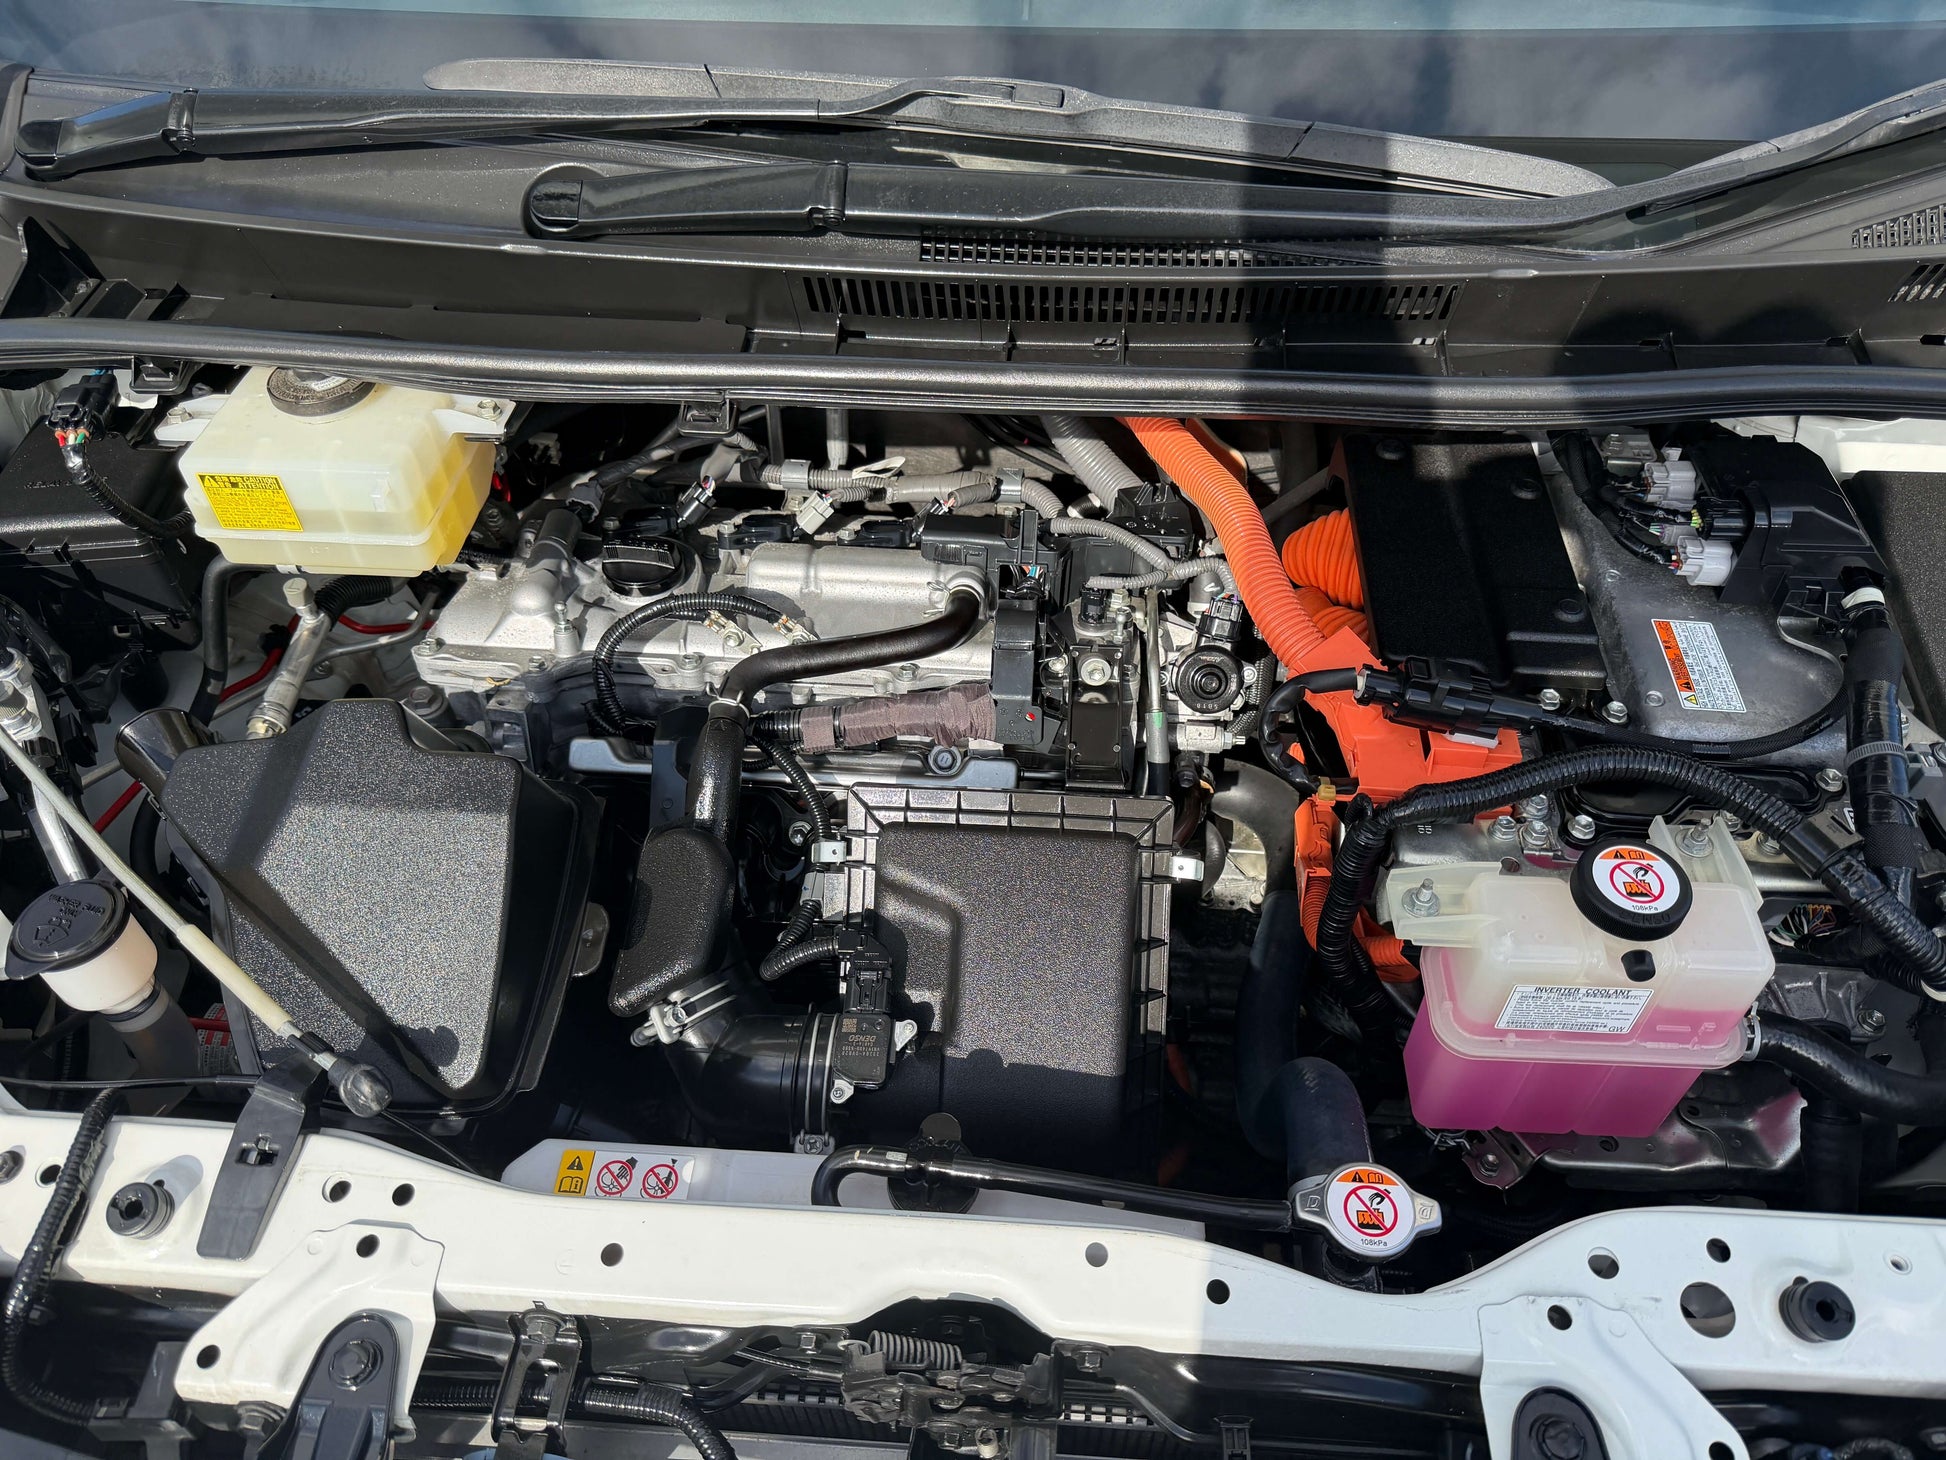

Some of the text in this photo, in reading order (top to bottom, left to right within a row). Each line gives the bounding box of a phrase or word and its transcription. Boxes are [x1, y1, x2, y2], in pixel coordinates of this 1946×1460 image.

[239, 482, 279, 490] ATTENTION
[1631, 904, 1659, 912] 108kPa
[1534, 986, 1632, 996] INVERTER COOLANT
[848, 1034, 877, 1042] DENSO
[1360, 1238, 1388, 1247] 108kPa
